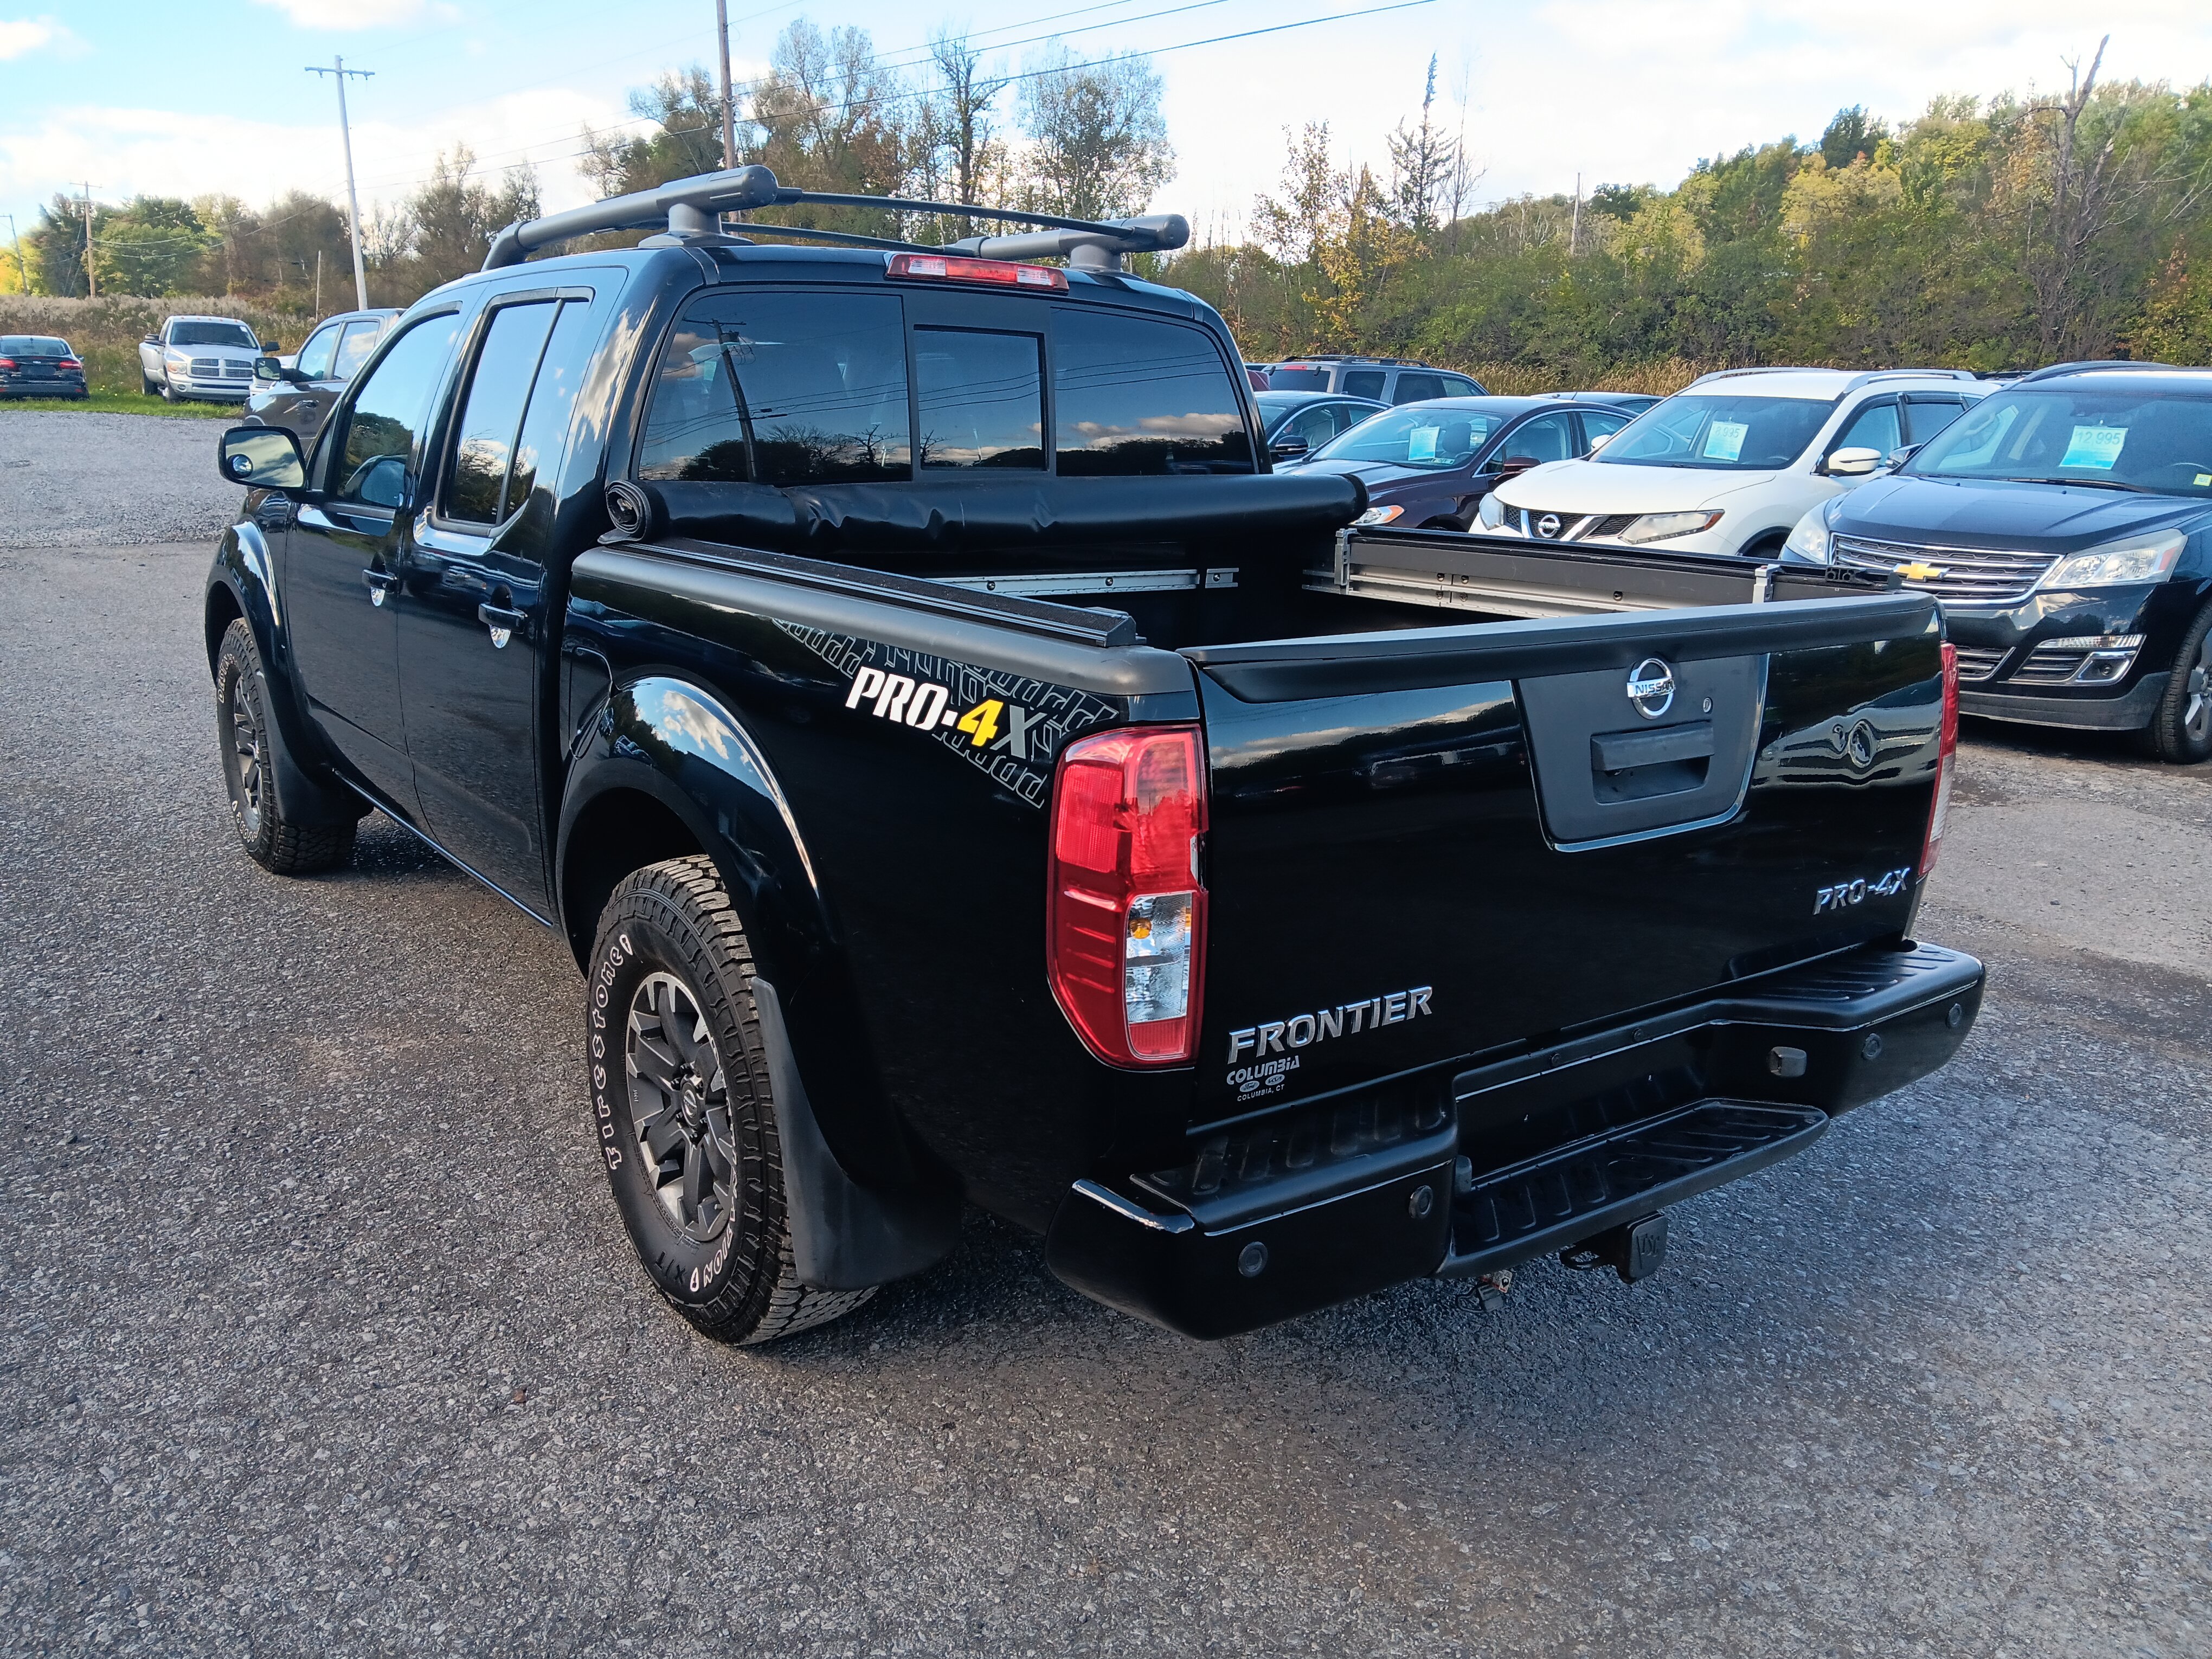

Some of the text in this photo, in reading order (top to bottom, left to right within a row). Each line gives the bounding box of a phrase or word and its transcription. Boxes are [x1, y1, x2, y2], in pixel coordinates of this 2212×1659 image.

[1635, 681, 1674, 695] NISSAN
[845, 666, 1047, 760] PRO-4X
[1812, 866, 1911, 915] PRO-4X
[1227, 985, 1433, 1065] FRONTIER
[1237, 1087, 1274, 1102] COLUMBIA,
